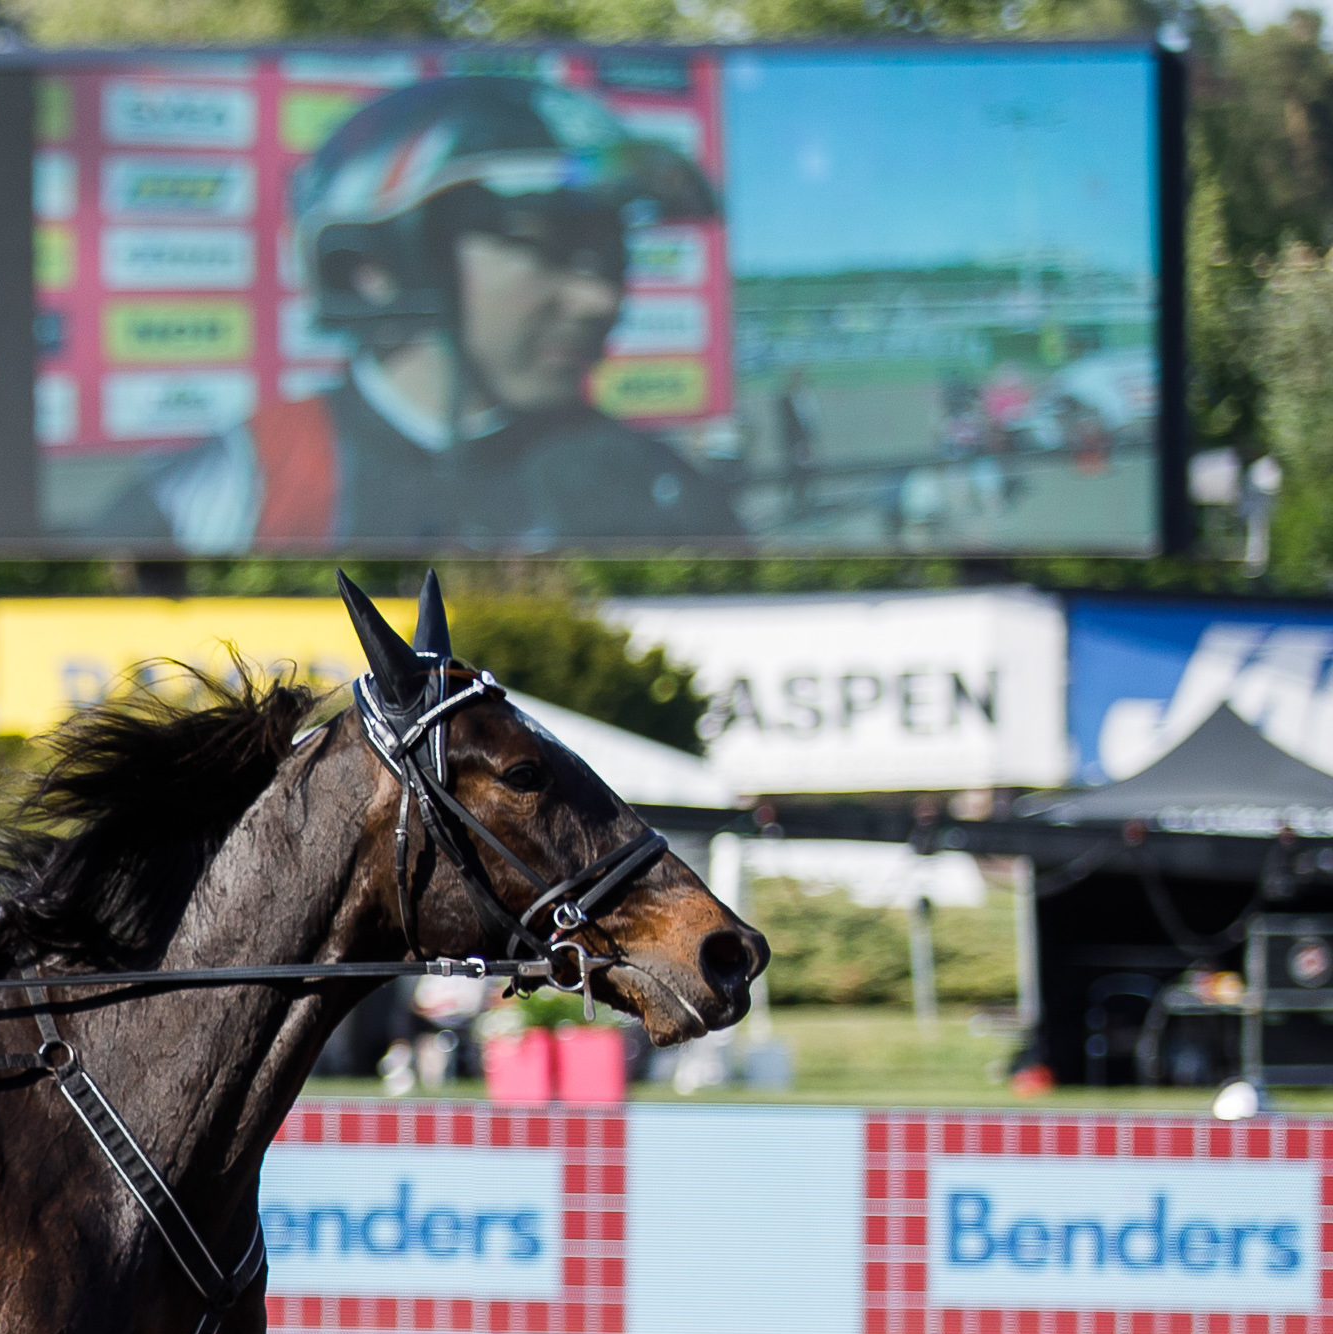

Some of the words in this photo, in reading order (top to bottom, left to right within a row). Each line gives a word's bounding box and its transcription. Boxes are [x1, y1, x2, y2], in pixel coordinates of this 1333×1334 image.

[729, 669, 1000, 731] ASPEN
[260, 1182, 541, 1258] enders
[946, 1190, 1304, 1271] Benders
